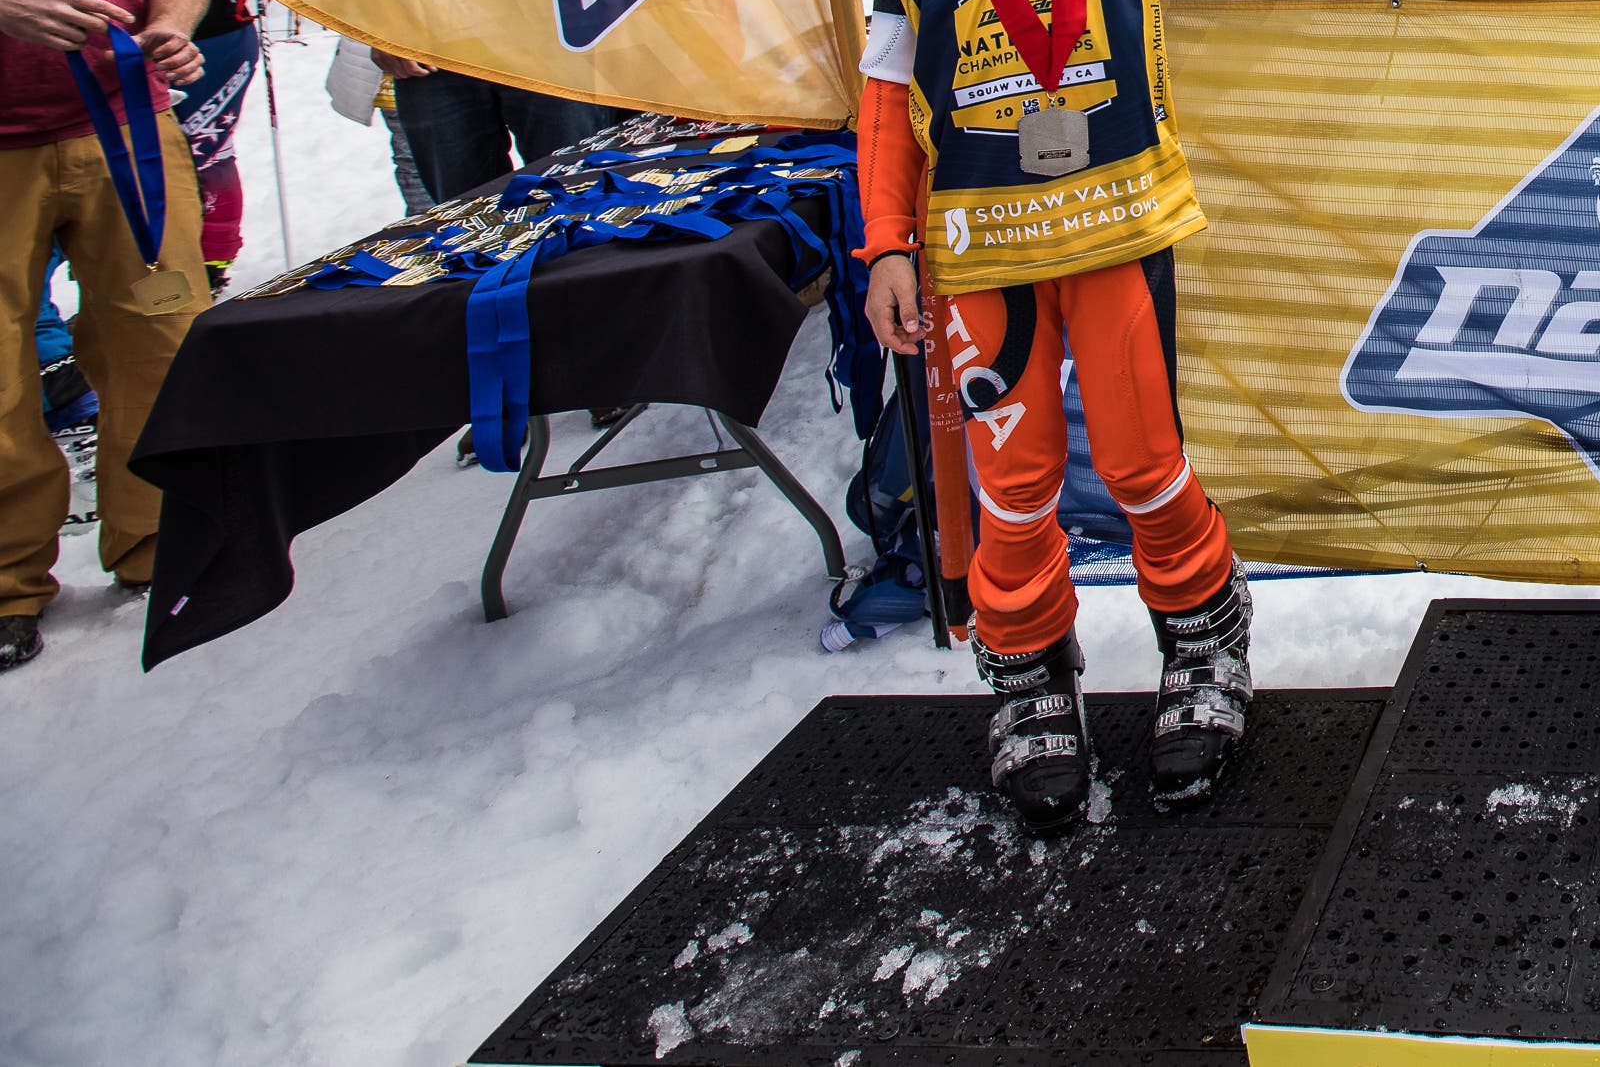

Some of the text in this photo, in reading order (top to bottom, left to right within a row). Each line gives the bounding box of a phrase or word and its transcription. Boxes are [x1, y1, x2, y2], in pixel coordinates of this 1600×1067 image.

[1150, 4, 1167, 101] Liberty Mutual
[968, 82, 1009, 99] SQUAW
[1076, 68, 1093, 78] CA
[975, 172, 1154, 223] SQUAW VALLEY
[984, 194, 1159, 247] ALPINE MEADOWS
[946, 296, 1027, 452] TICA
